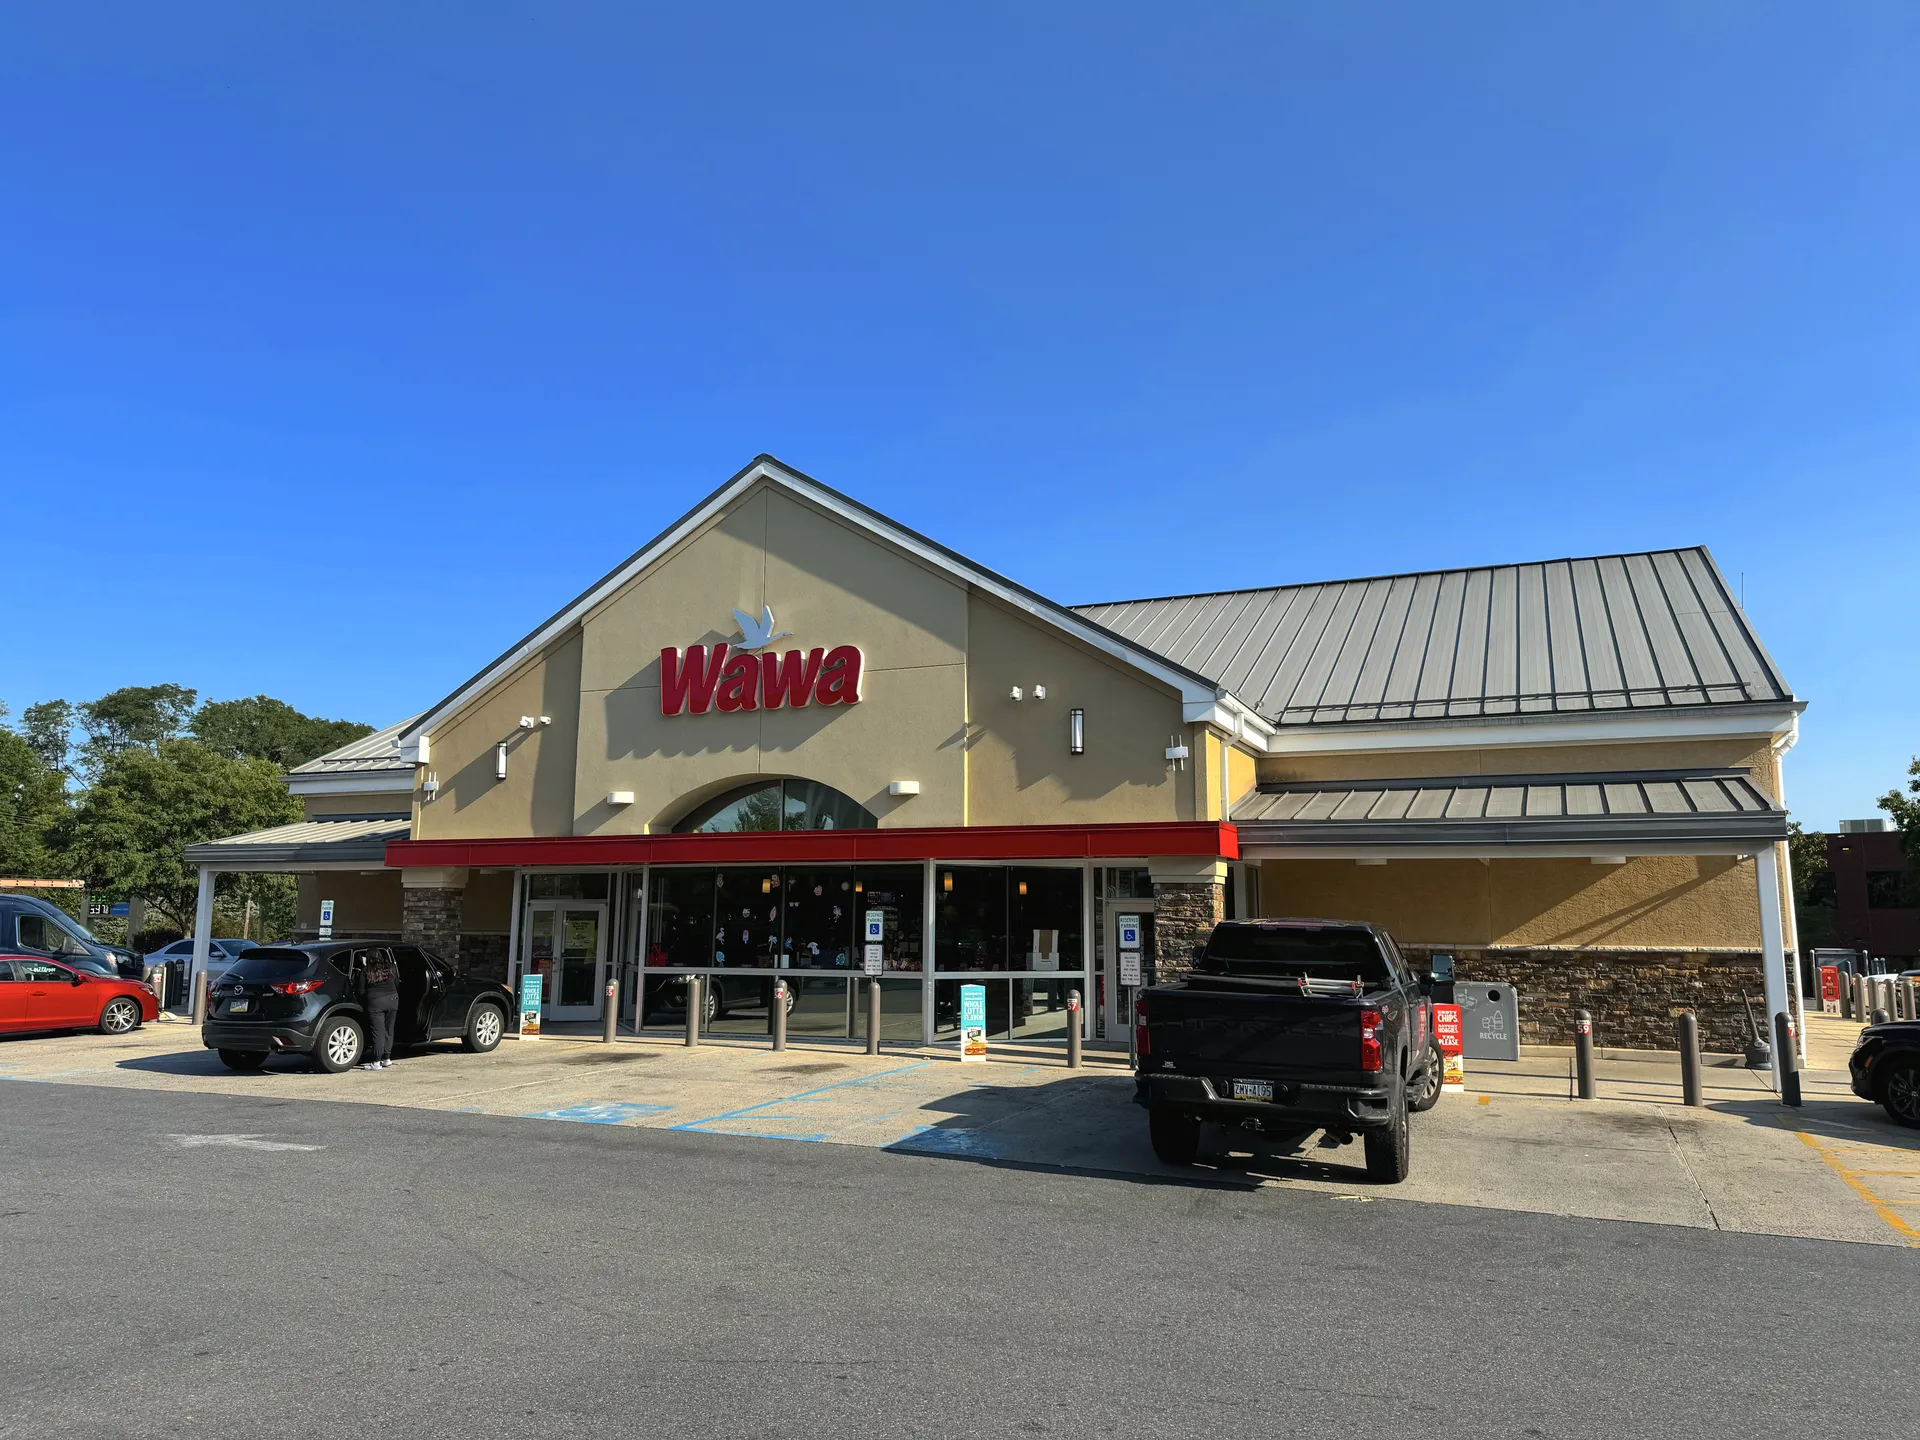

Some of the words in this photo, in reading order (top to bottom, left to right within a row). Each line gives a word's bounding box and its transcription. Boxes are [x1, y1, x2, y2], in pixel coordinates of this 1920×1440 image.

[660, 643, 865, 716] Wawa
[1067, 1002, 1077, 1011] 57
[1577, 1024, 1589, 1034] 59
[1480, 1032, 1508, 1040] RECYCLE
